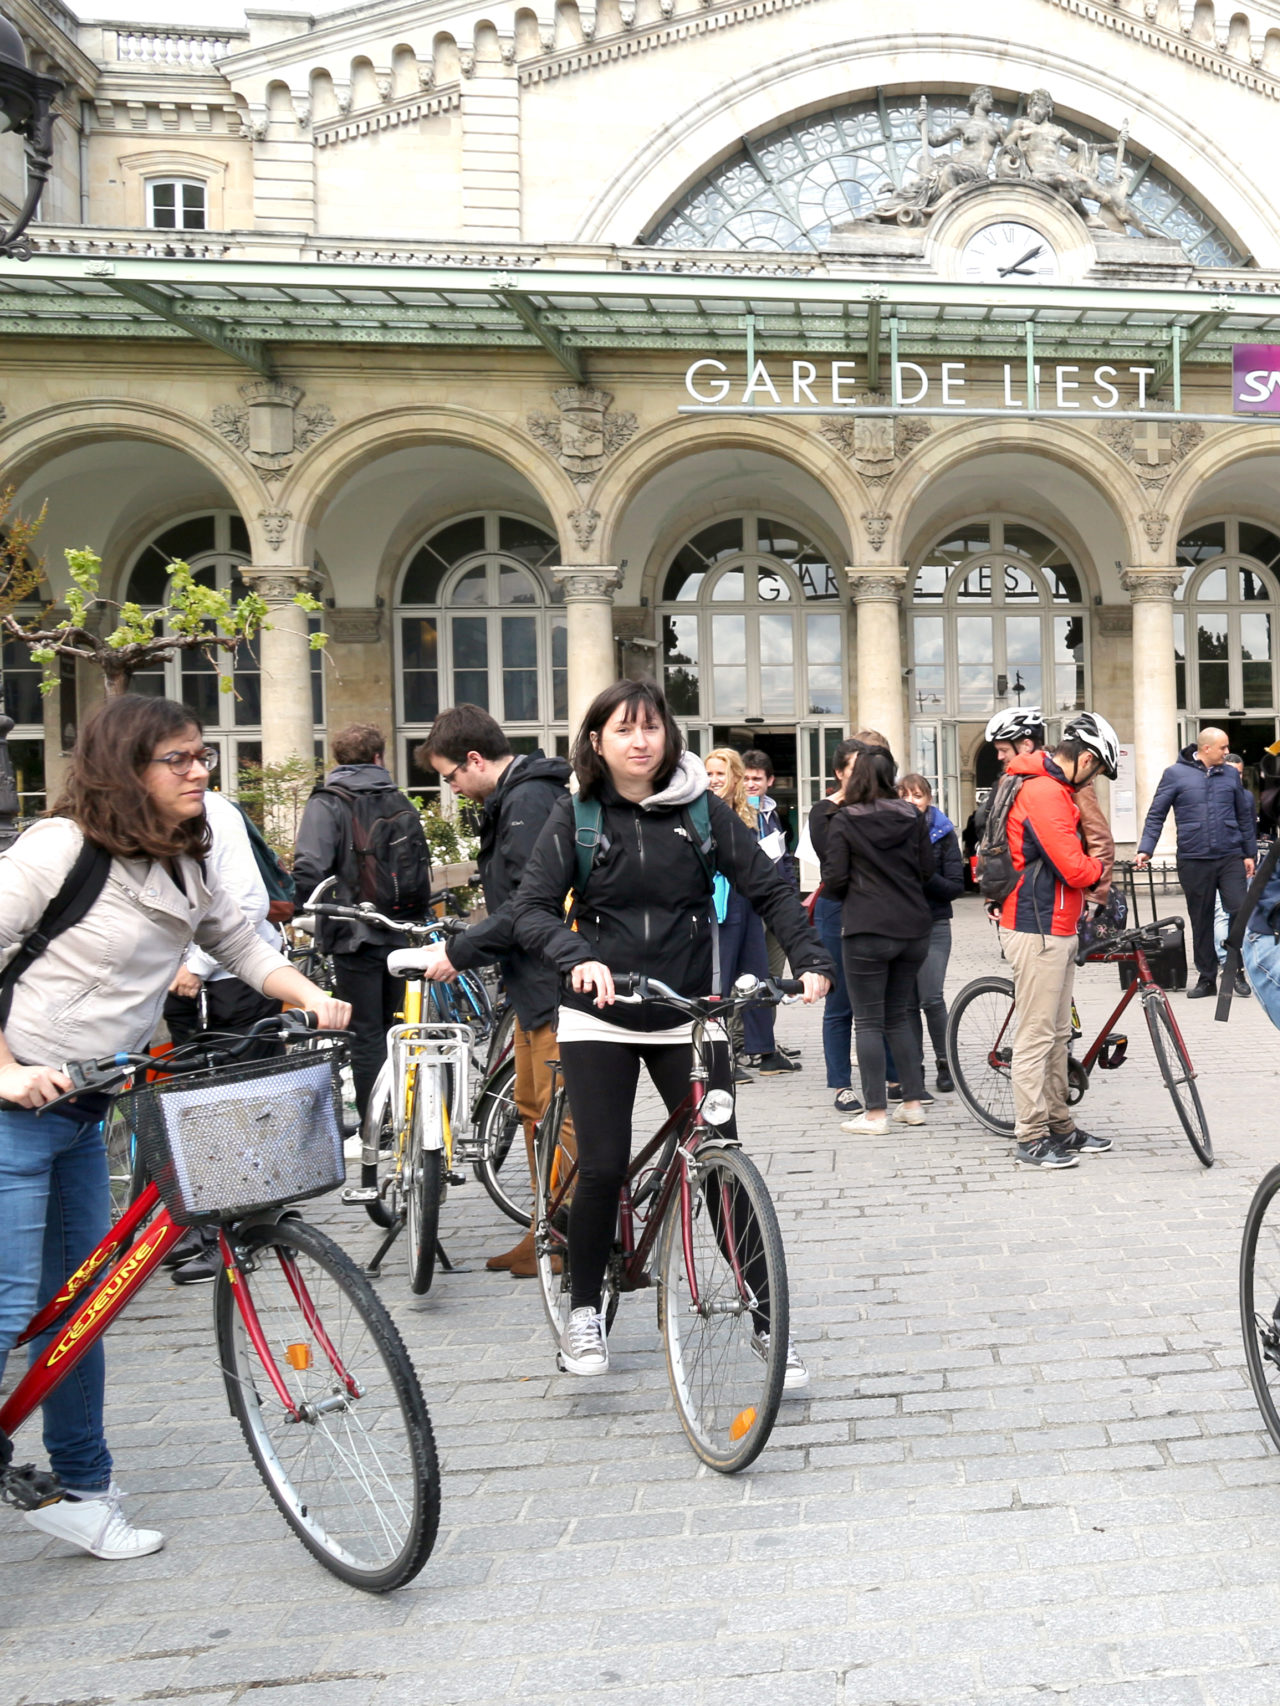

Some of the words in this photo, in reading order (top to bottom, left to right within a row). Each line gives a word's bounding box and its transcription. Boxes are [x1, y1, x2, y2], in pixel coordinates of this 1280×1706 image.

[685, 359, 857, 404] GARE
[894, 361, 966, 405] DE
[1003, 364, 1156, 409] L'EST
[55, 1248, 109, 1303] VTC
[59, 1242, 152, 1352] LEJEUNE
